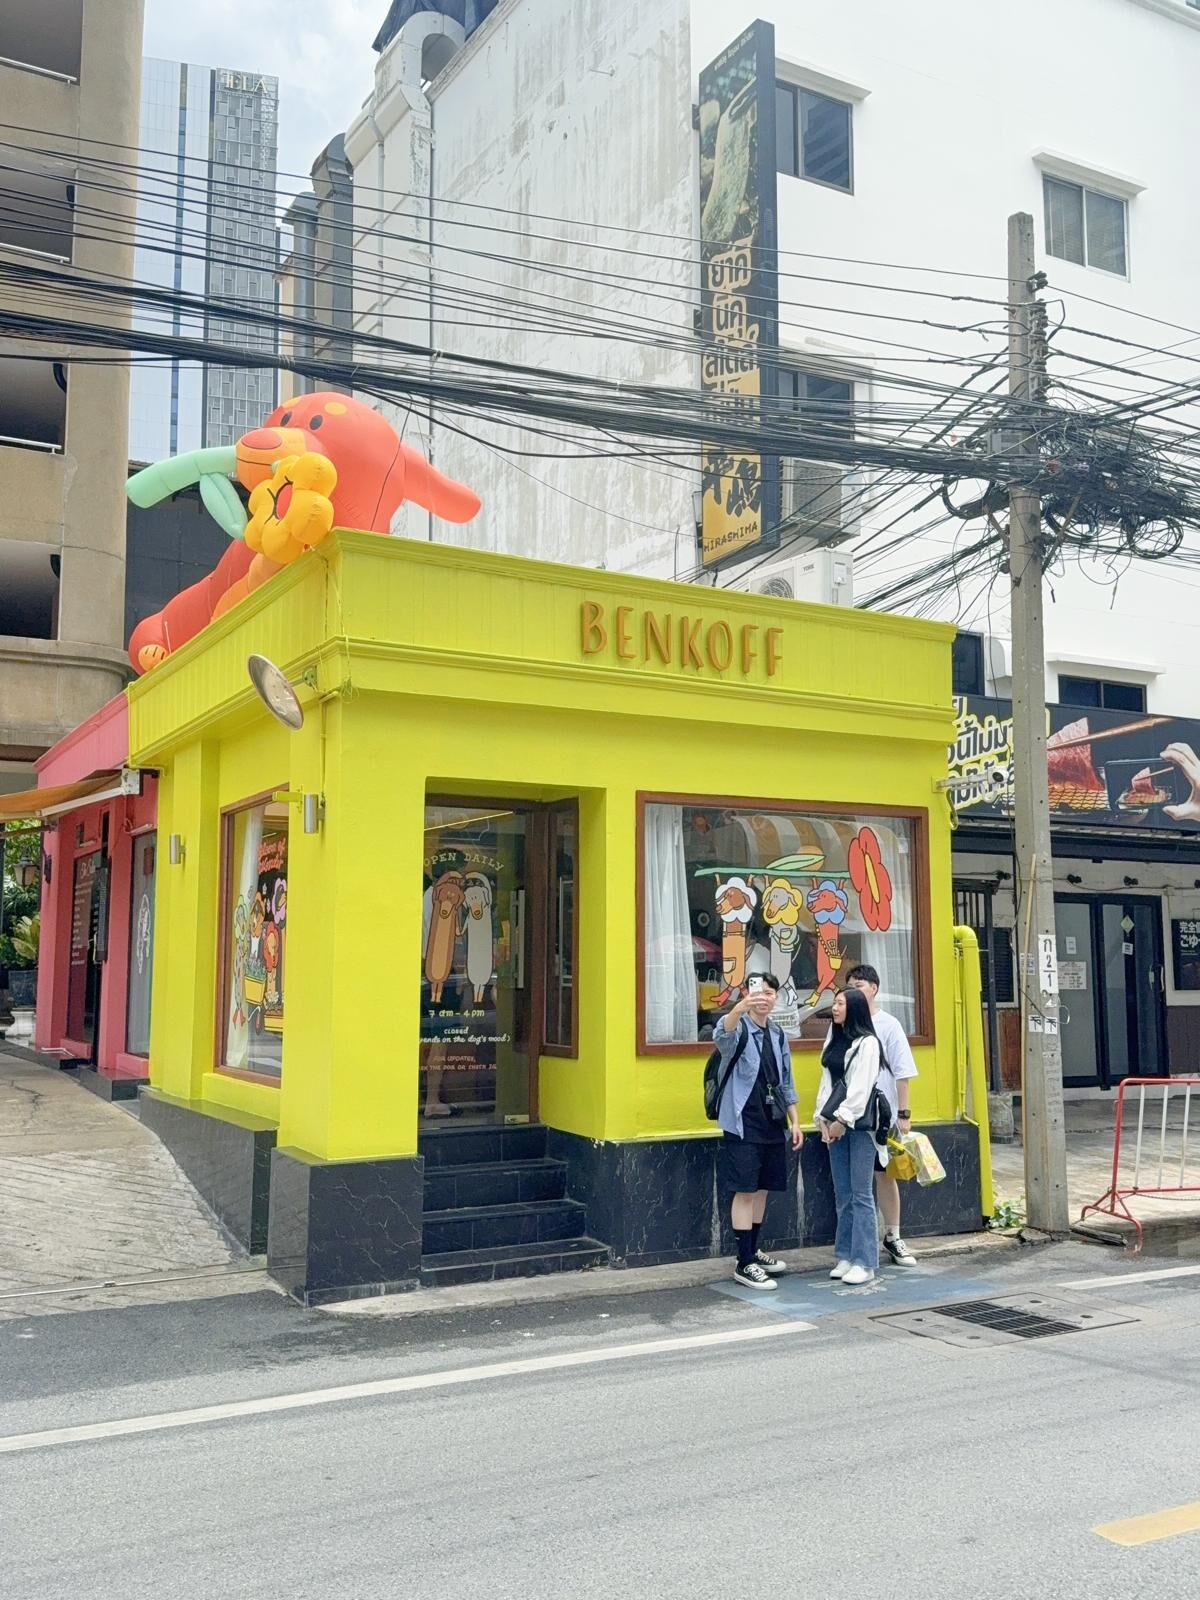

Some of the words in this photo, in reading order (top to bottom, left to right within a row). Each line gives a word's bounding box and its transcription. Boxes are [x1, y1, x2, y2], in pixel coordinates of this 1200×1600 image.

[703, 521, 758, 553] HIRASHIMA
[580, 600, 785, 677] BENKOFF
[424, 852, 457, 866] OPEN
[463, 852, 505, 871] DAILY
[1046, 955, 1052, 968] 2
[1047, 973, 1052, 987] 1
[428, 1010, 435, 1019] 7
[439, 1009, 454, 1017] am
[453, 1035, 466, 1044] the
[467, 1034, 487, 1046] dog's
